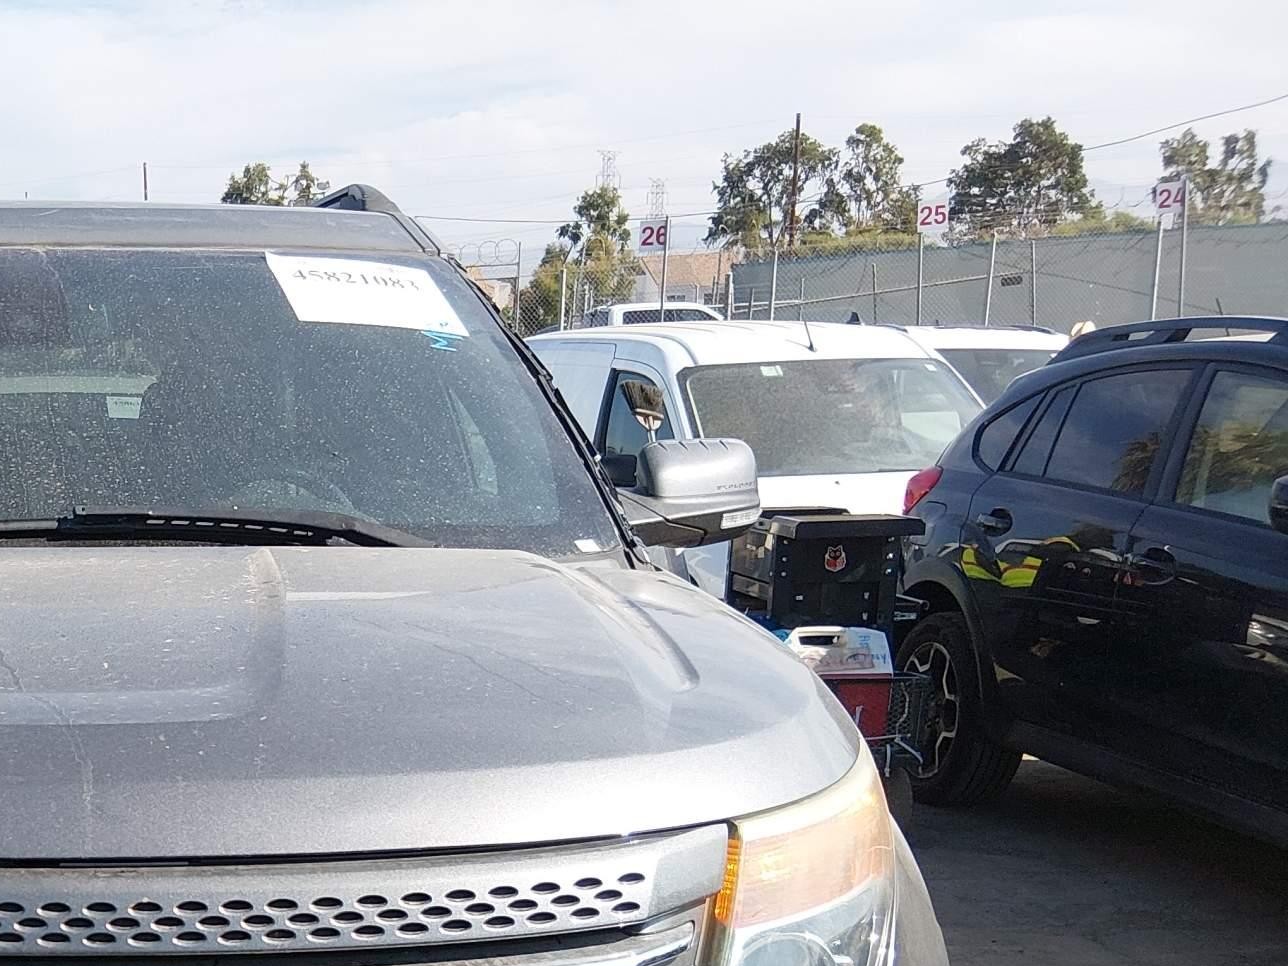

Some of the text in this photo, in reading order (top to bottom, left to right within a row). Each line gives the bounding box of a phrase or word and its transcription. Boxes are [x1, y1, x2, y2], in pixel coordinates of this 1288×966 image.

[1158, 187, 1184, 208] 24
[919, 204, 946, 226] 25
[641, 225, 666, 246] 26
